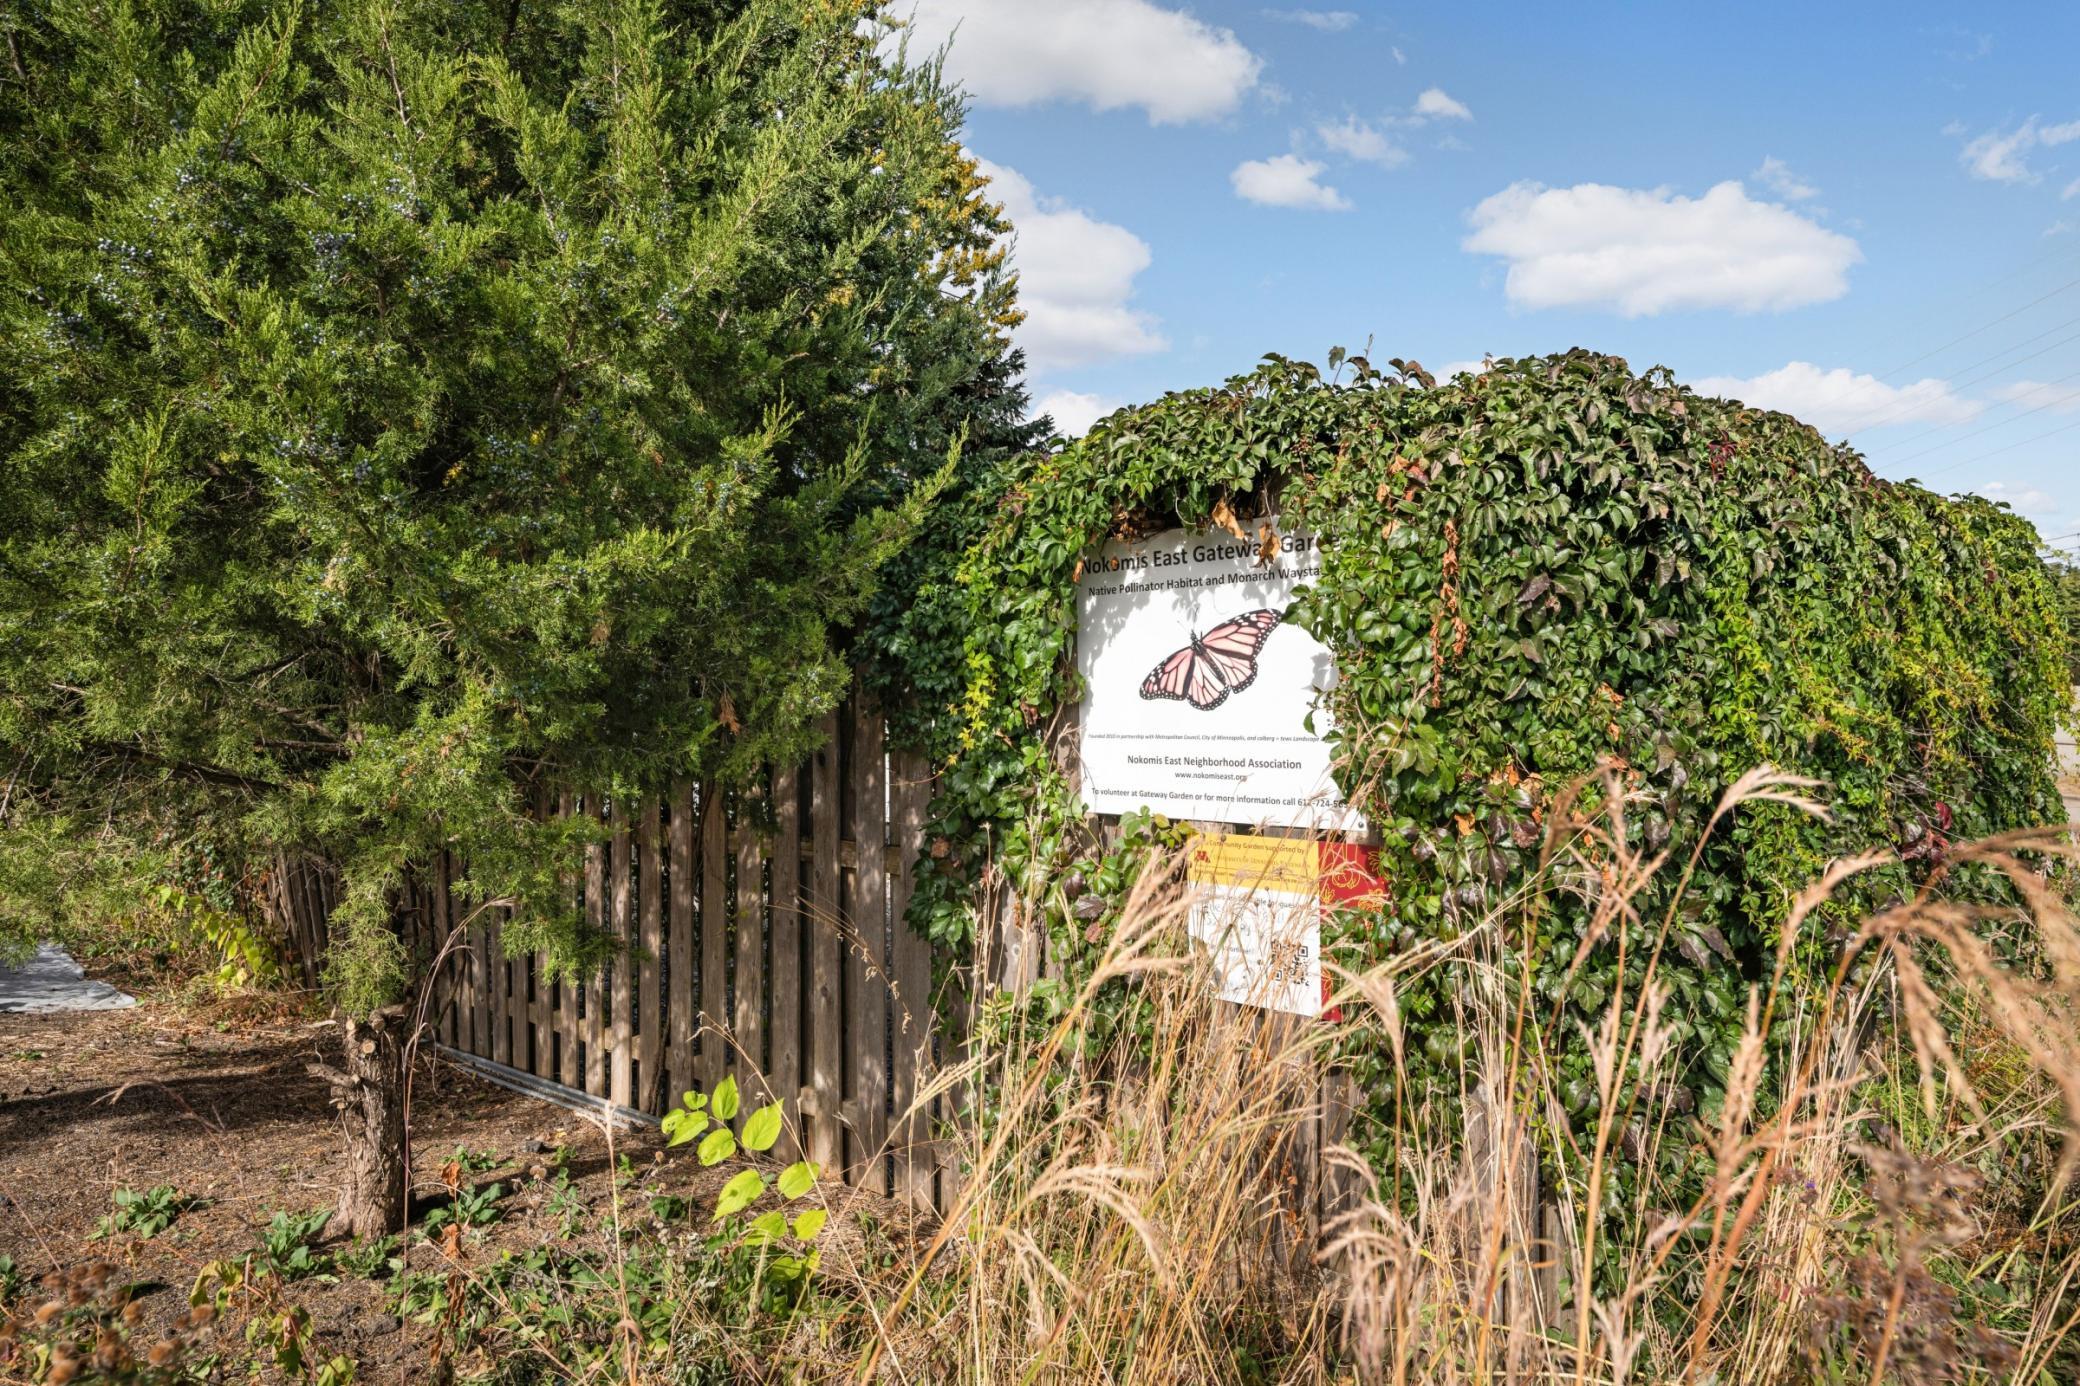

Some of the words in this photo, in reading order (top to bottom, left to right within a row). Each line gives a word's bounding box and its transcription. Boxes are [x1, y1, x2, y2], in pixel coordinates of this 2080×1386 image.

[1082, 554, 1149, 575] Nokomis
[1153, 548, 1188, 567] East
[1193, 543, 1263, 563] Gatewa
[1088, 584, 1117, 597] Native
[1119, 581, 1165, 594] Pollinator
[1167, 578, 1203, 590] Habitat
[1205, 574, 1225, 587] and
[1228, 569, 1275, 584] Monarch
[1278, 566, 1322, 580] Waysta
[1201, 734, 1211, 742] City
[1211, 734, 1217, 742] of
[1127, 755, 1163, 765] Nokomis
[1164, 756, 1182, 766] East
[1184, 756, 1246, 769] Neighborhood
[1248, 758, 1302, 769] Association
[1175, 771, 1247, 782] www.nokomiseast.or
[1092, 787, 1100, 795] To
[1100, 788, 1130, 797] volunteer
[1139, 790, 1168, 800] Gateway
[1169, 791, 1194, 800] Garden
[1204, 792, 1214, 801] for
[1236, 795, 1281, 805] information
[1282, 797, 1296, 806] call
[1243, 841, 1265, 850] Garden
[1296, 847, 1305, 855] by
